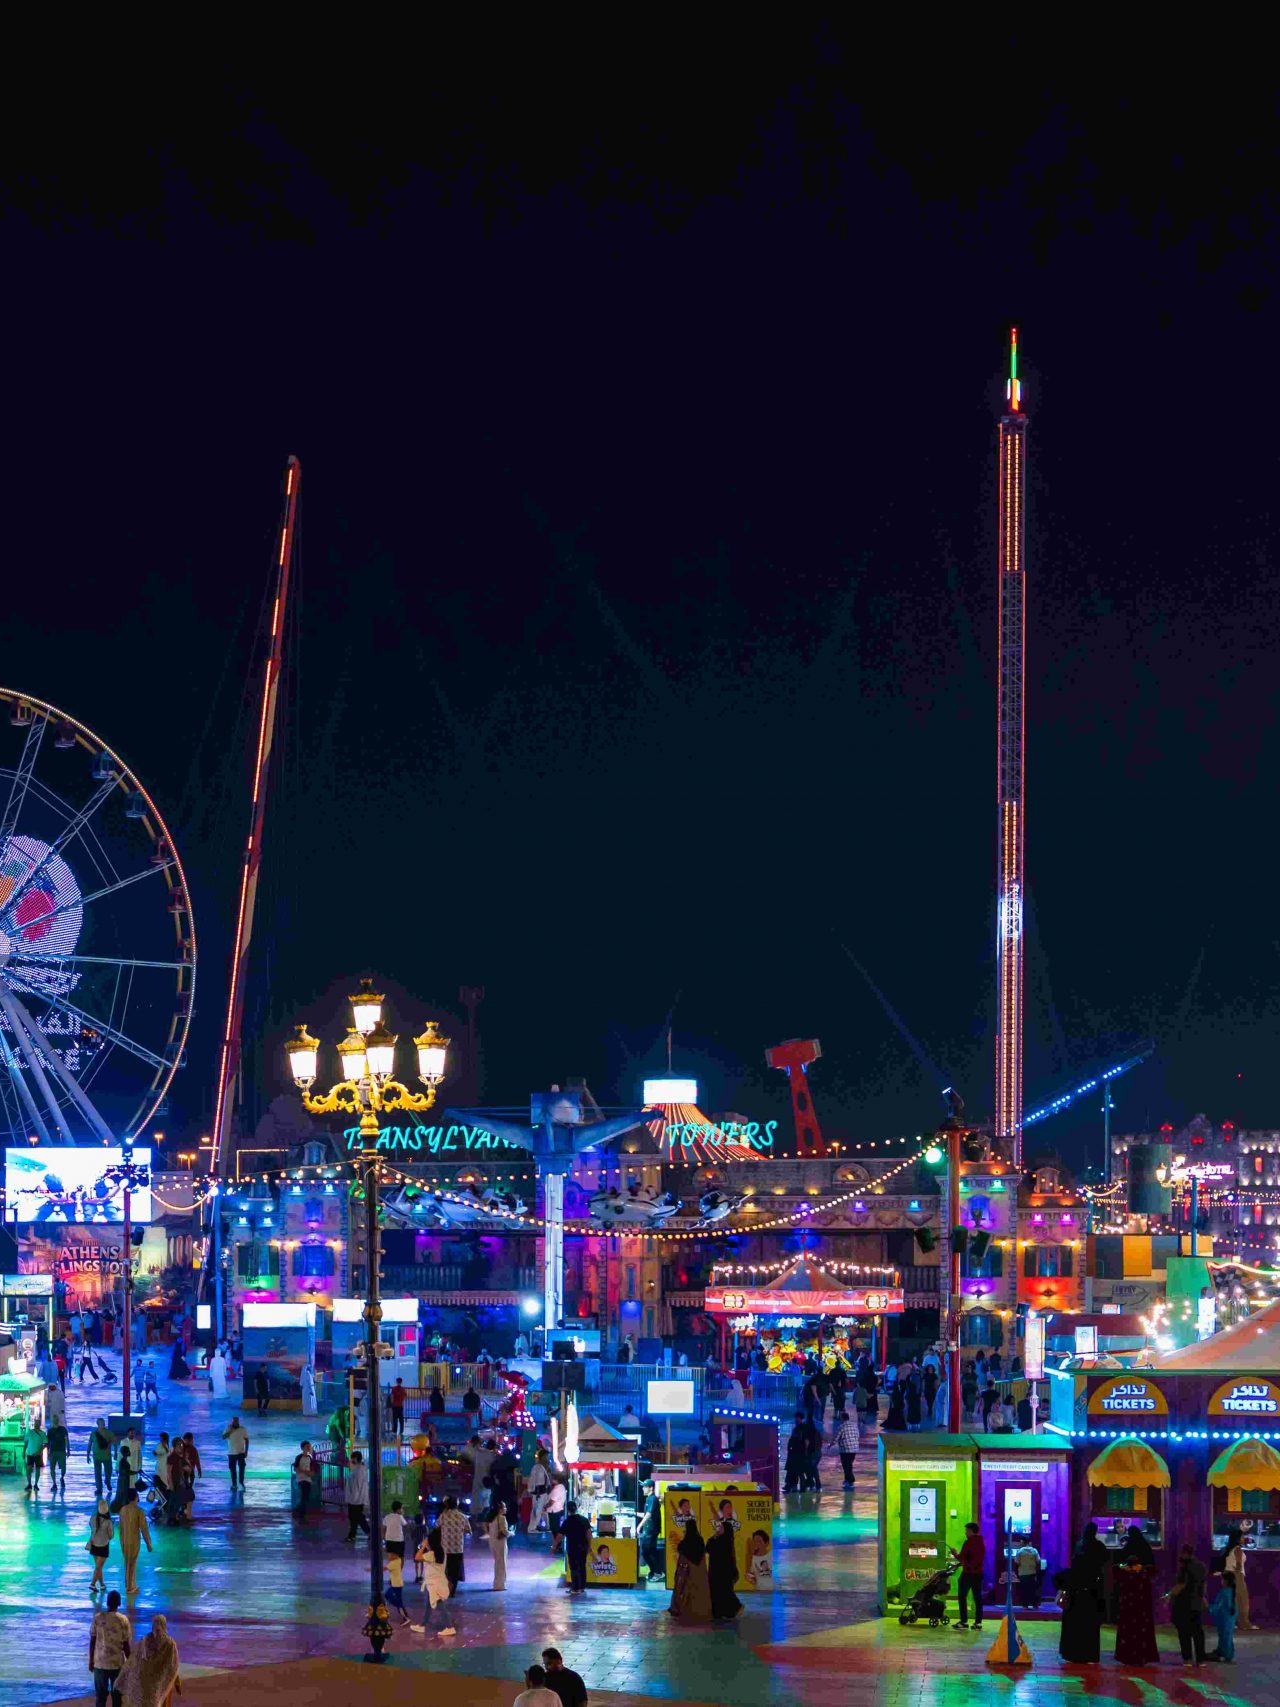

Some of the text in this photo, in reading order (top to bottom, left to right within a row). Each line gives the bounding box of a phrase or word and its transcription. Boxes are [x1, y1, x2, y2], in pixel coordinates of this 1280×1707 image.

[666, 1120, 778, 1149] TOWERS
[60, 1246, 119, 1260] ATHENS
[1110, 1384, 1147, 1398] تذاكر
[1231, 1385, 1269, 1399] تذاكر
[1102, 1398, 1155, 1410] TICKETS
[1222, 1399, 1277, 1411] TICKETS
